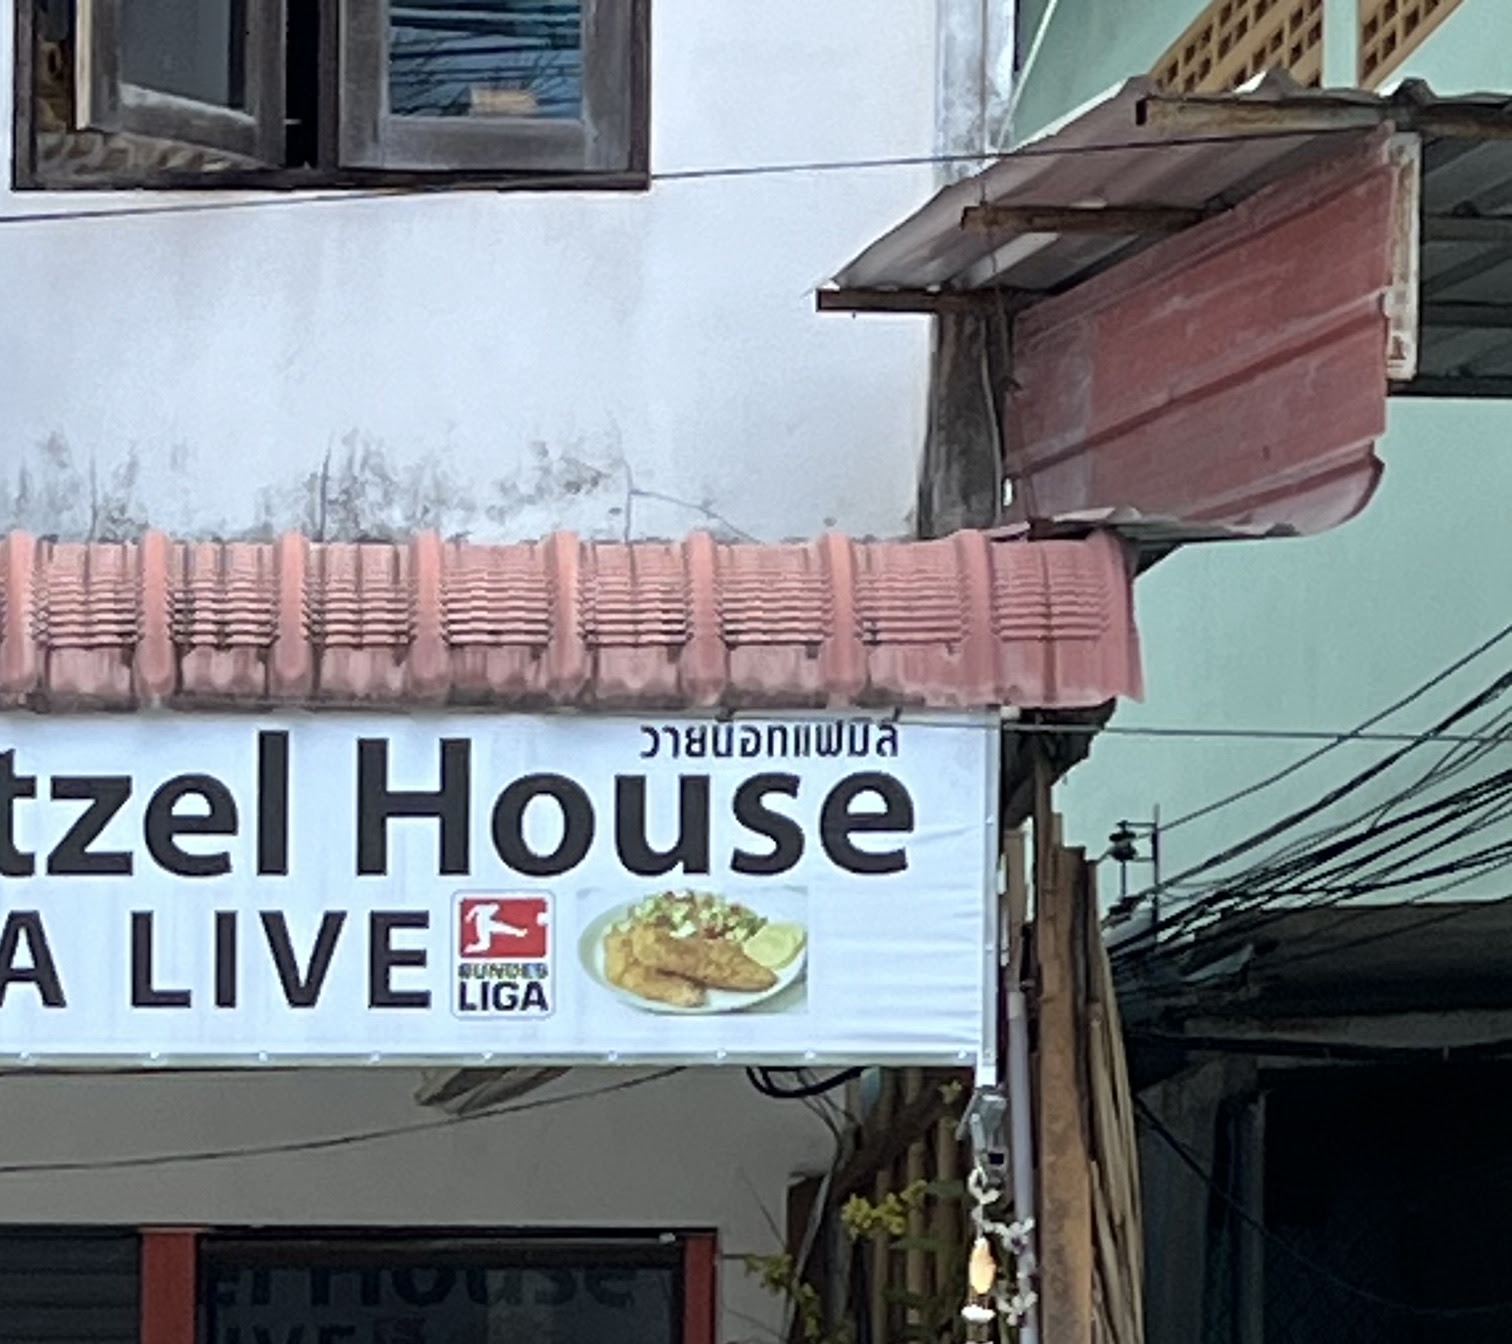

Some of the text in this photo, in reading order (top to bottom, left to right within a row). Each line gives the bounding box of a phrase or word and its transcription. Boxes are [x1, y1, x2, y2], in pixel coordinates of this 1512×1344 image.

[355, 737, 915, 878] House
[130, 910, 432, 1009] LIVE
[458, 981, 549, 1012] LIGA
